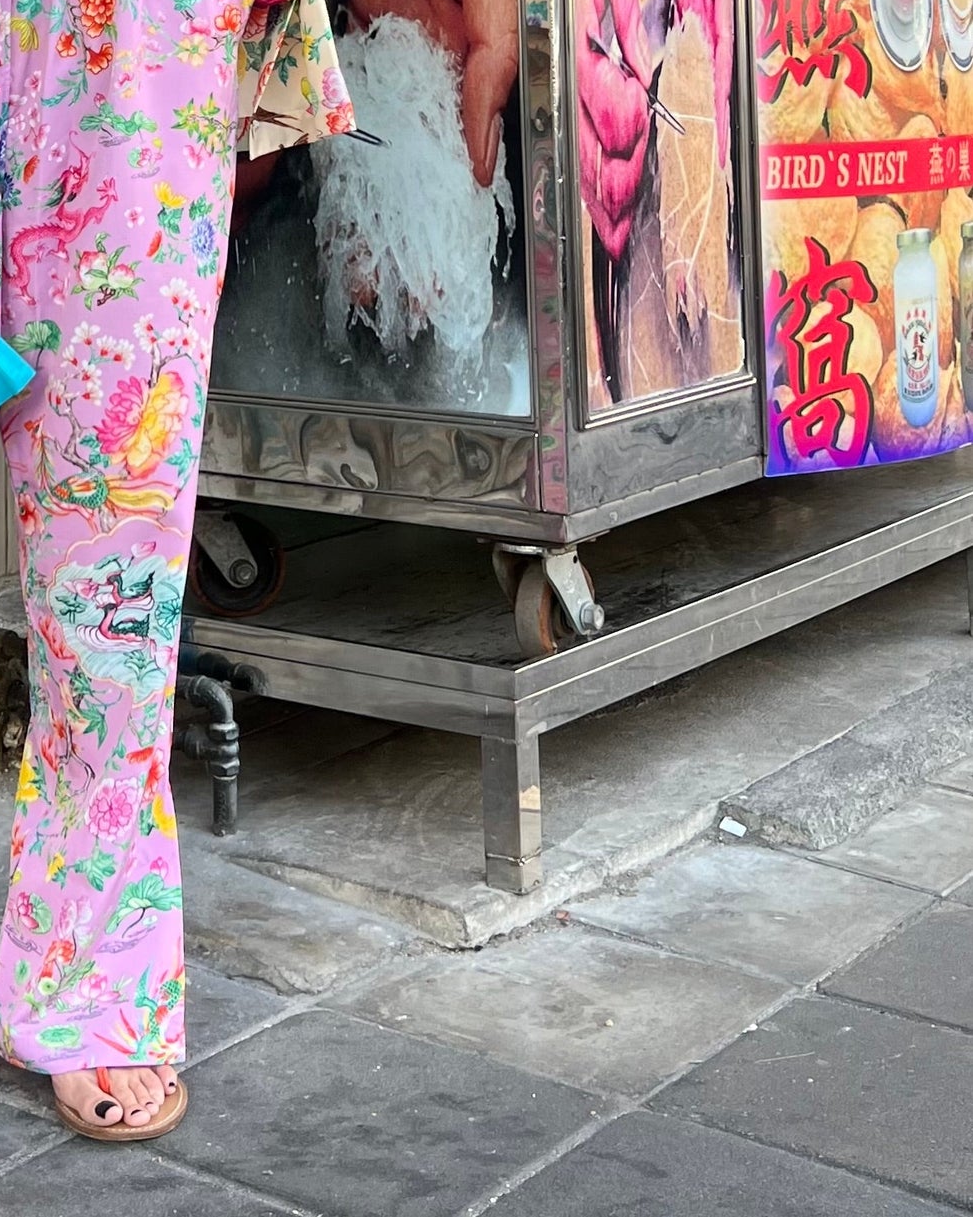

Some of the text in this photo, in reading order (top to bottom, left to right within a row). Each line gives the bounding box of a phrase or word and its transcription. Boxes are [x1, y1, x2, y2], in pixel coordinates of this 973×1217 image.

[856, 150, 908, 186] NEST
[928, 141, 971, 184] 燕の巣
